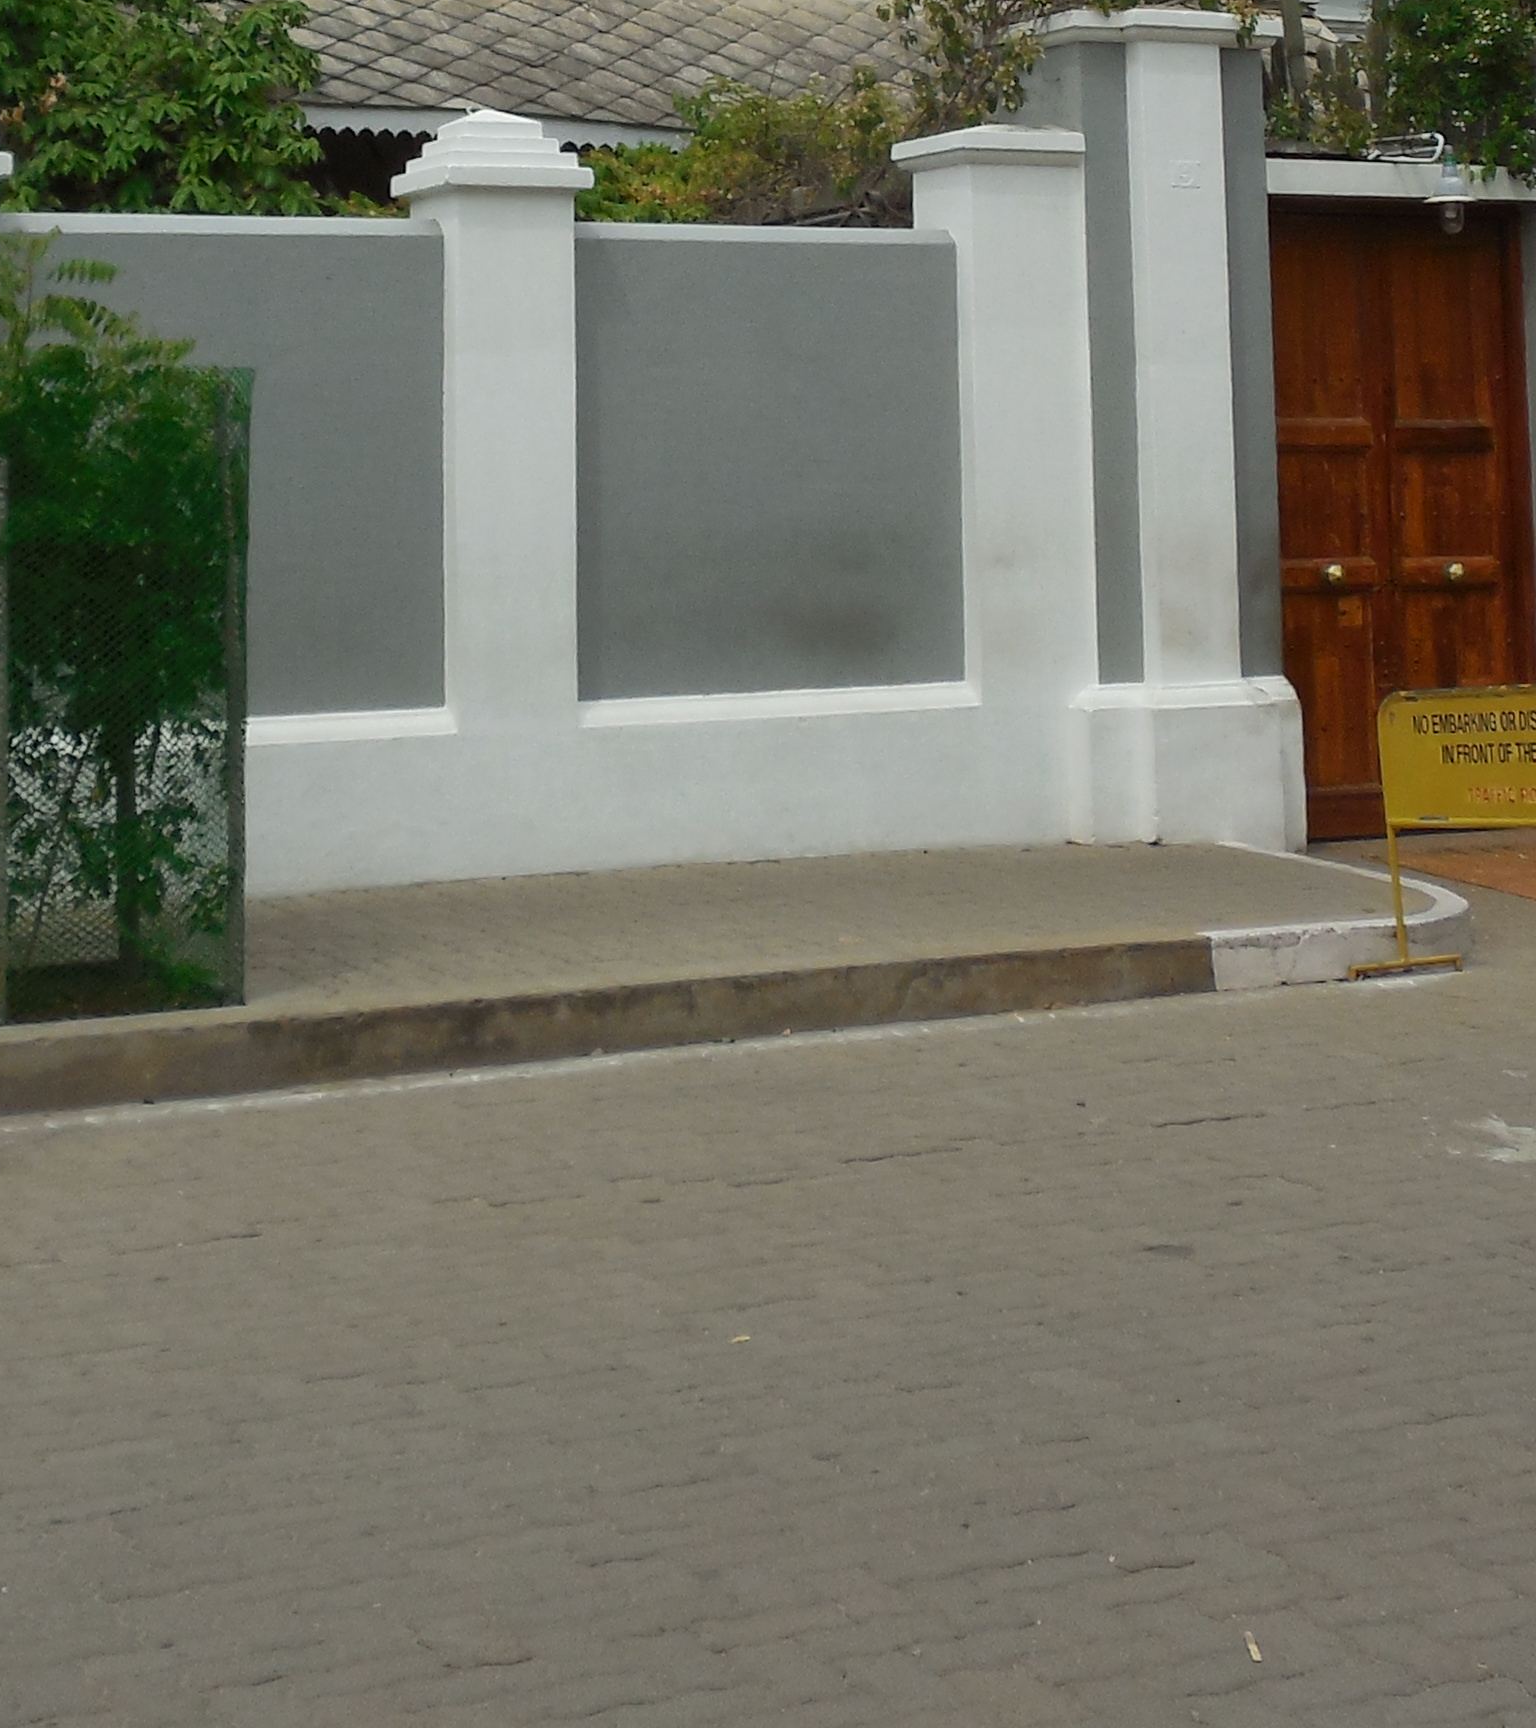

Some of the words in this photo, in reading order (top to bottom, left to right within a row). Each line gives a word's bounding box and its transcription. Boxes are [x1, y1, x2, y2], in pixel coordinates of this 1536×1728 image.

[1412, 715, 1430, 734] NO
[1432, 712, 1497, 734] EMBARKING
[1500, 711, 1515, 732] OR
[1441, 744, 1454, 764] IN
[1456, 742, 1495, 764] FRONT
[1498, 742, 1514, 763] OF
